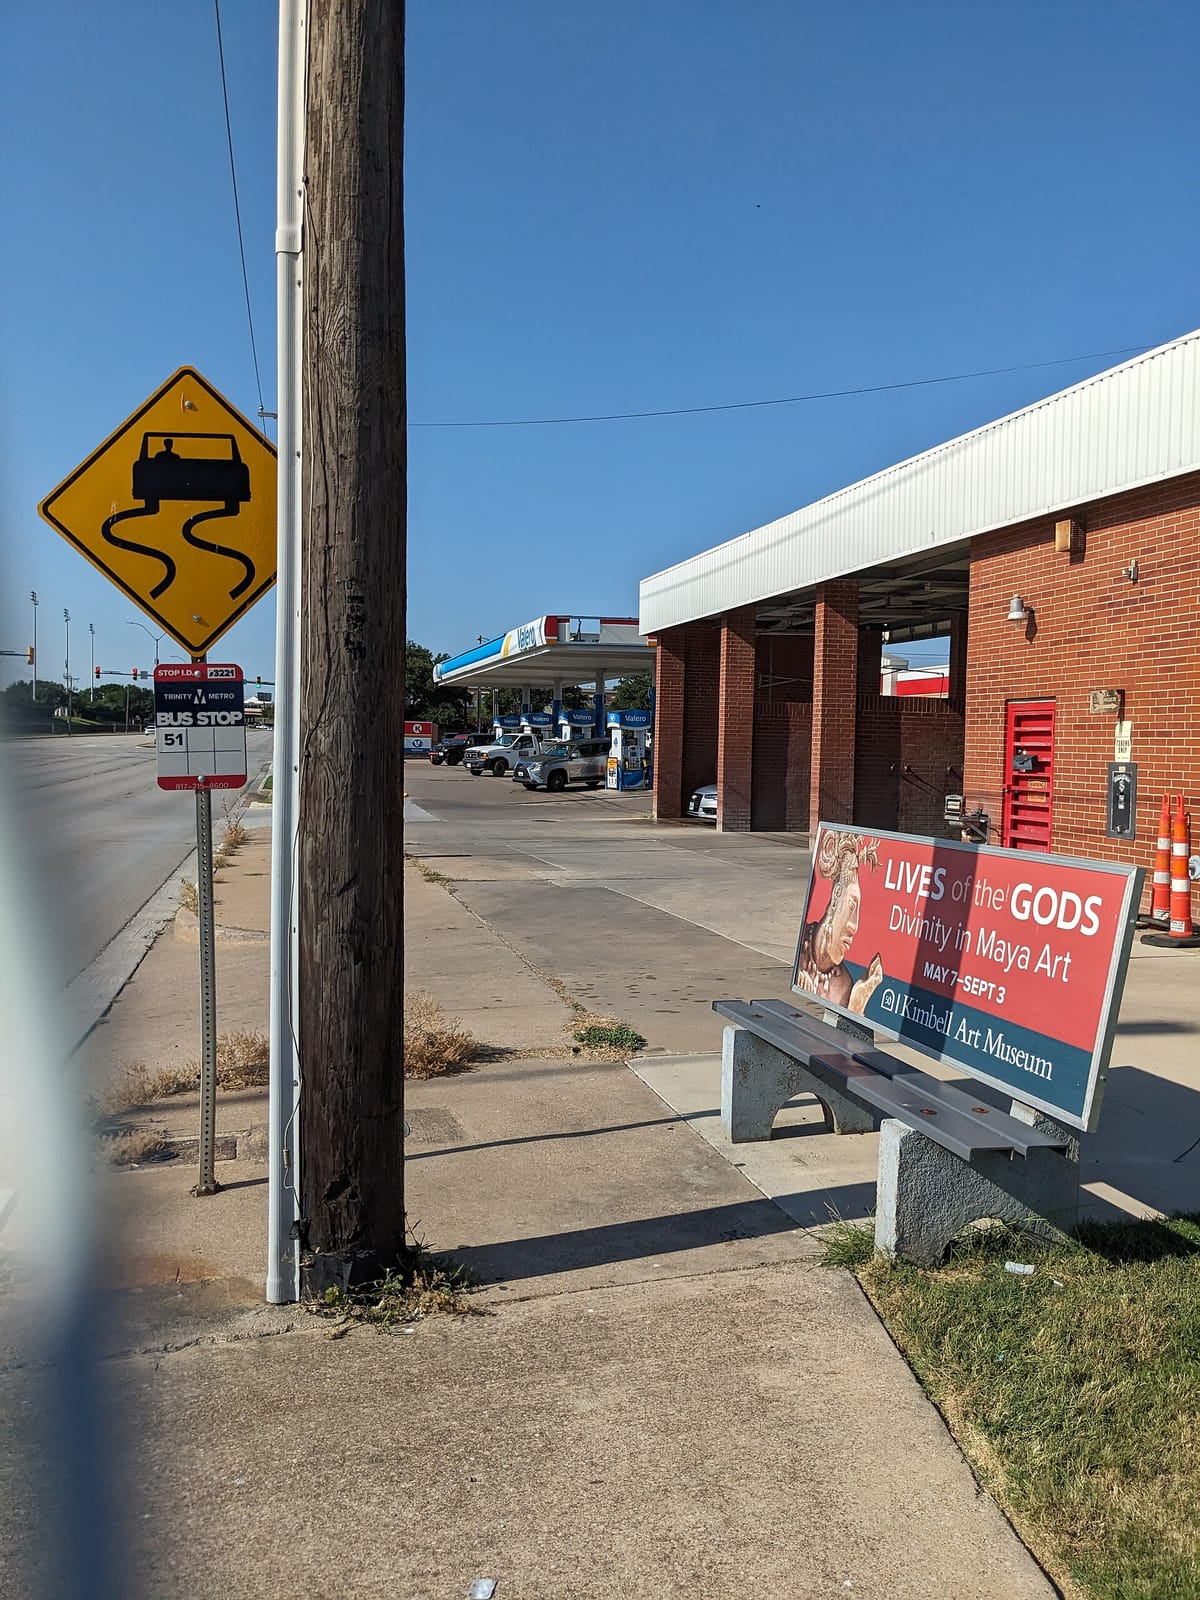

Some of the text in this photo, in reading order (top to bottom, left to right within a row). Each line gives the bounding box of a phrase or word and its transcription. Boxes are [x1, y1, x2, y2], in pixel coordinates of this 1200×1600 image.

[158, 669, 180, 677] STOP
[208, 692, 235, 700] METRO
[156, 711, 243, 726] BUS STOP
[532, 715, 550, 723] Valero
[572, 713, 592, 721] Valero
[625, 714, 647, 722] Valero
[164, 733, 183, 746] 51
[884, 858, 1103, 937] LIVES of the GODS
[888, 904, 1072, 983] Divinity in Maya Art
[923, 961, 949, 983] MAY
[996, 986, 1006, 1005] 3
[901, 993, 1053, 1082] Kimbell Art Museum
